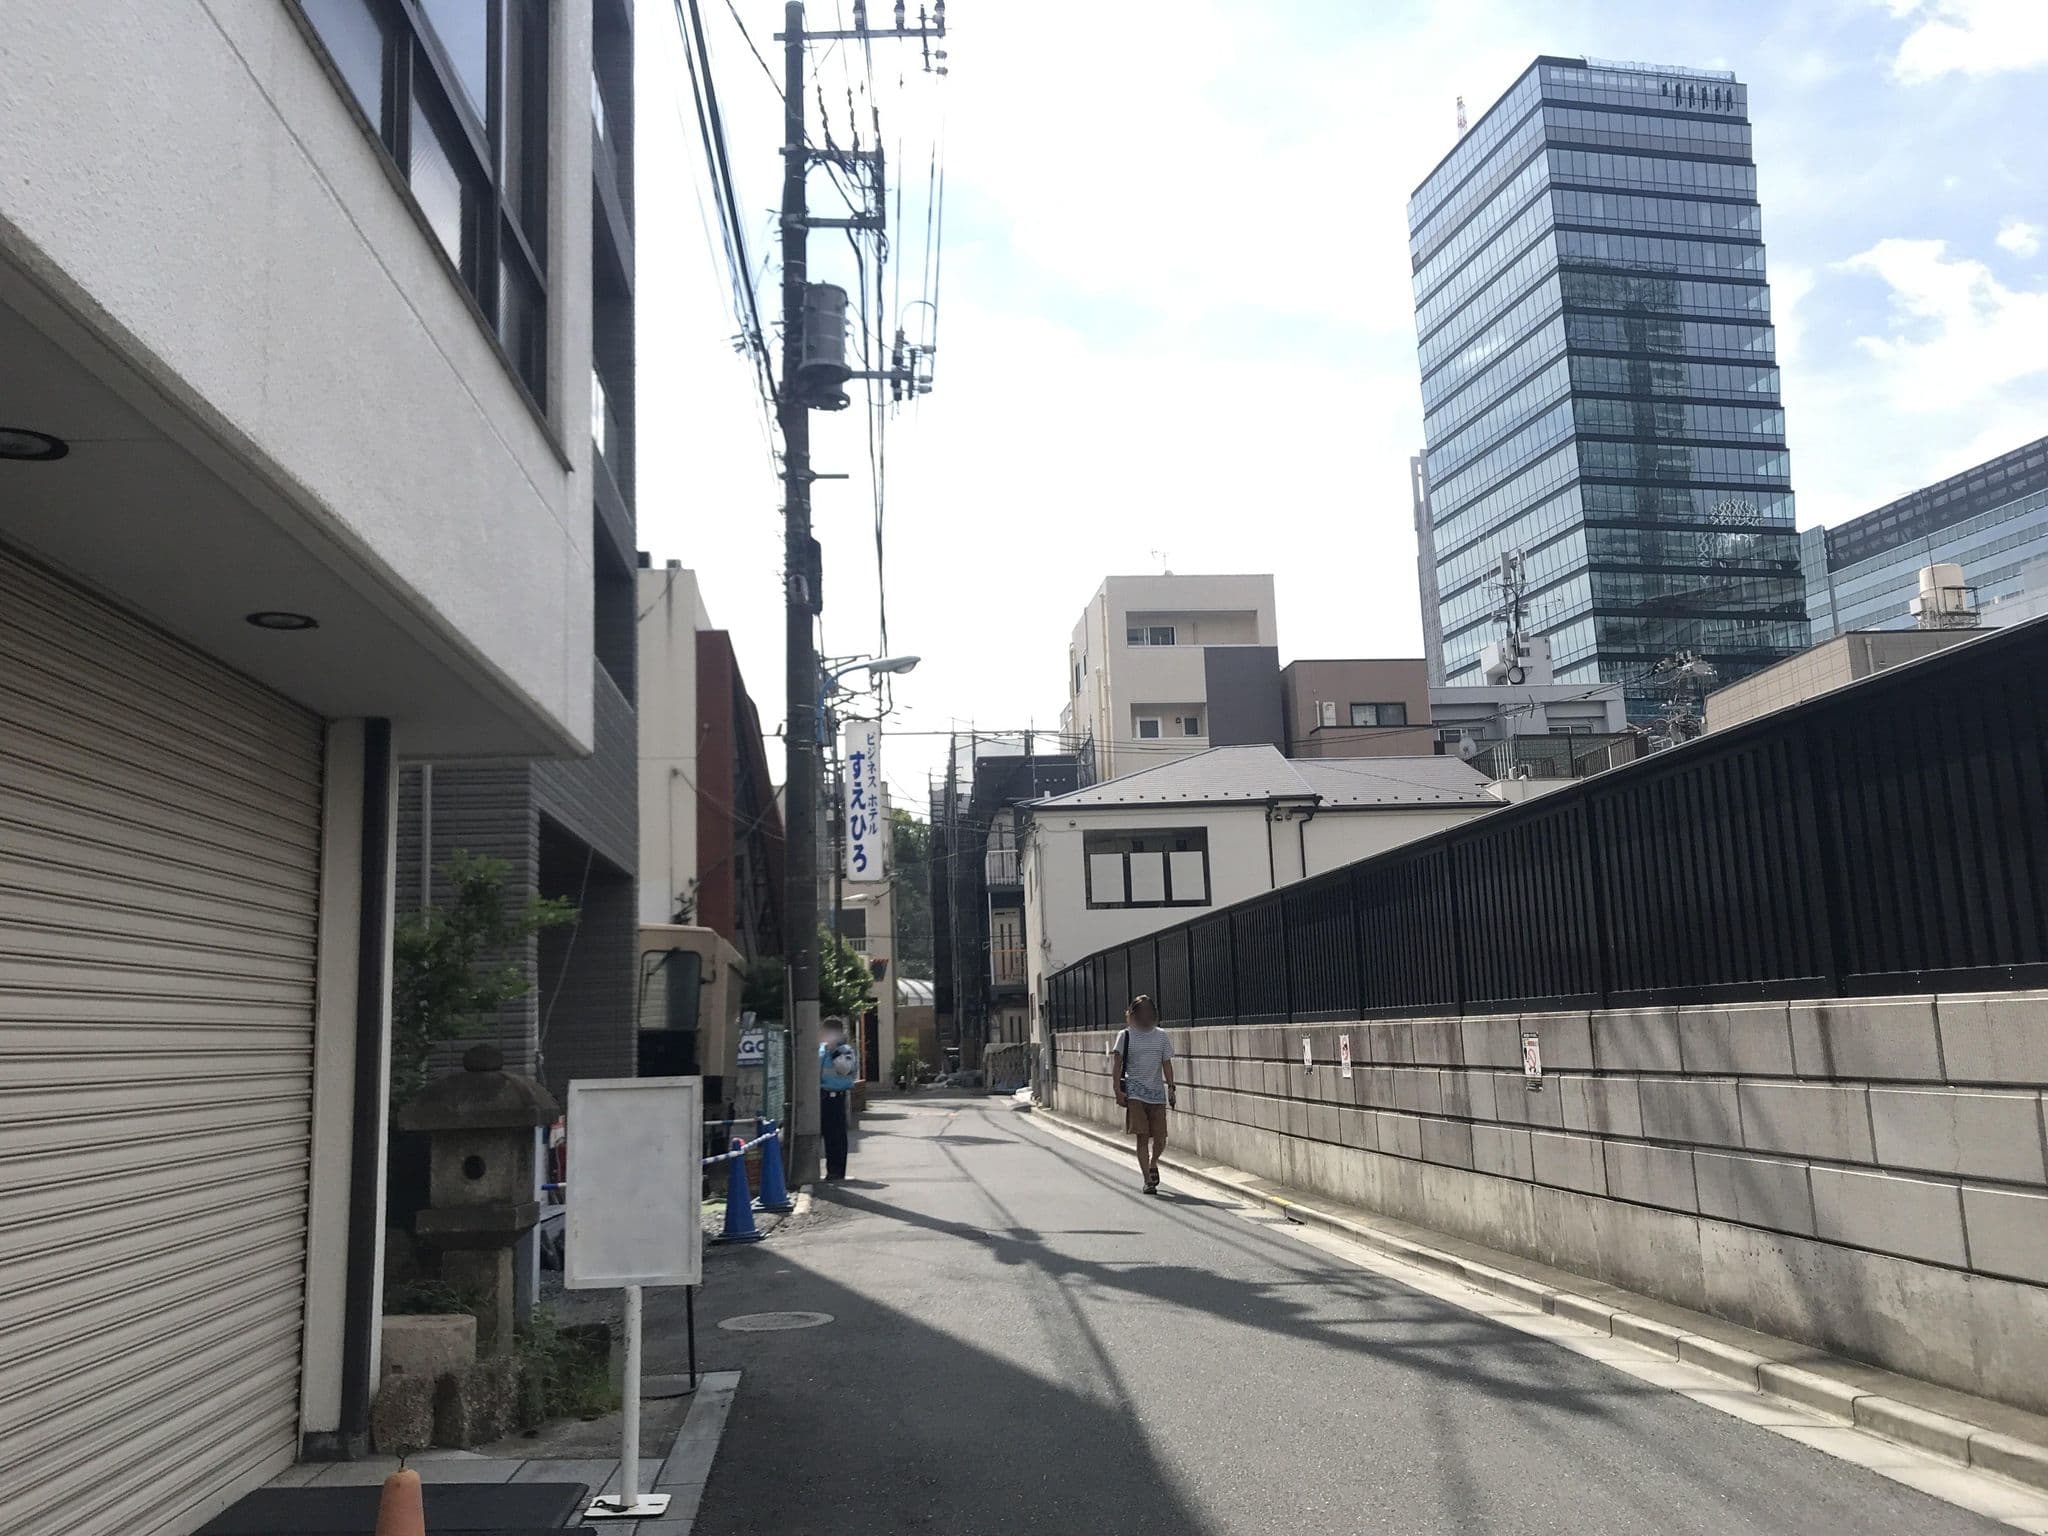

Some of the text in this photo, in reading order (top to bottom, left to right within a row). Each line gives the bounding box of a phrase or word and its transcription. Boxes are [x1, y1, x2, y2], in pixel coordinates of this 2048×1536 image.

[849, 751, 867, 872] すえひろ
[866, 733, 878, 835] ビジネス ホテル
